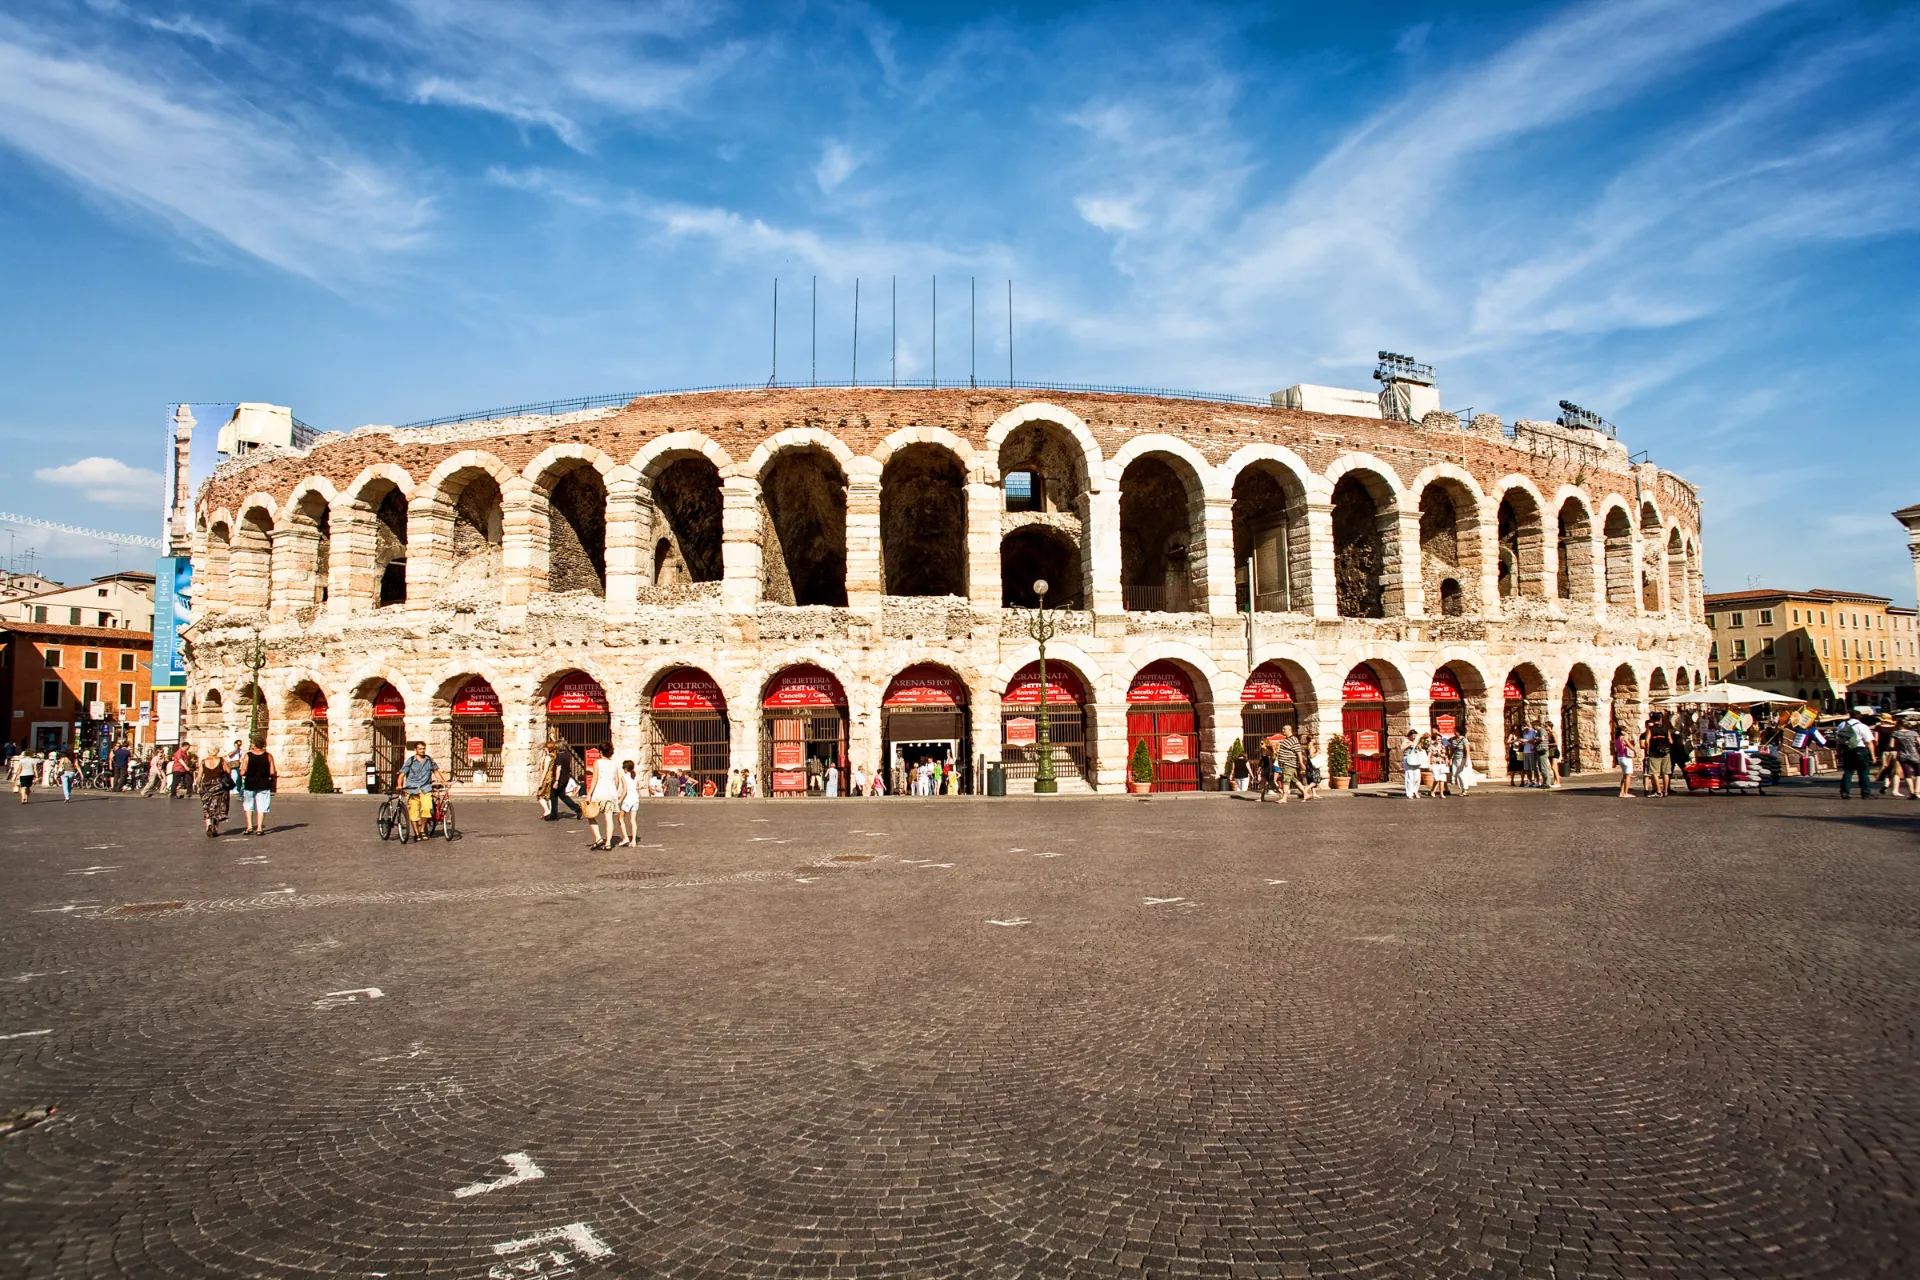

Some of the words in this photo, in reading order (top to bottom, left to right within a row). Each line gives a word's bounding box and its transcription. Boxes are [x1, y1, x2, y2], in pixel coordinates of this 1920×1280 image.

[1013, 672, 1069, 680] GRADNATA
[782, 677, 831, 685] BIGLIETTERIA
[893, 679, 926, 687] ARENA
[667, 682, 718, 690] POLTRONE
[780, 684, 806, 692] TICKET
